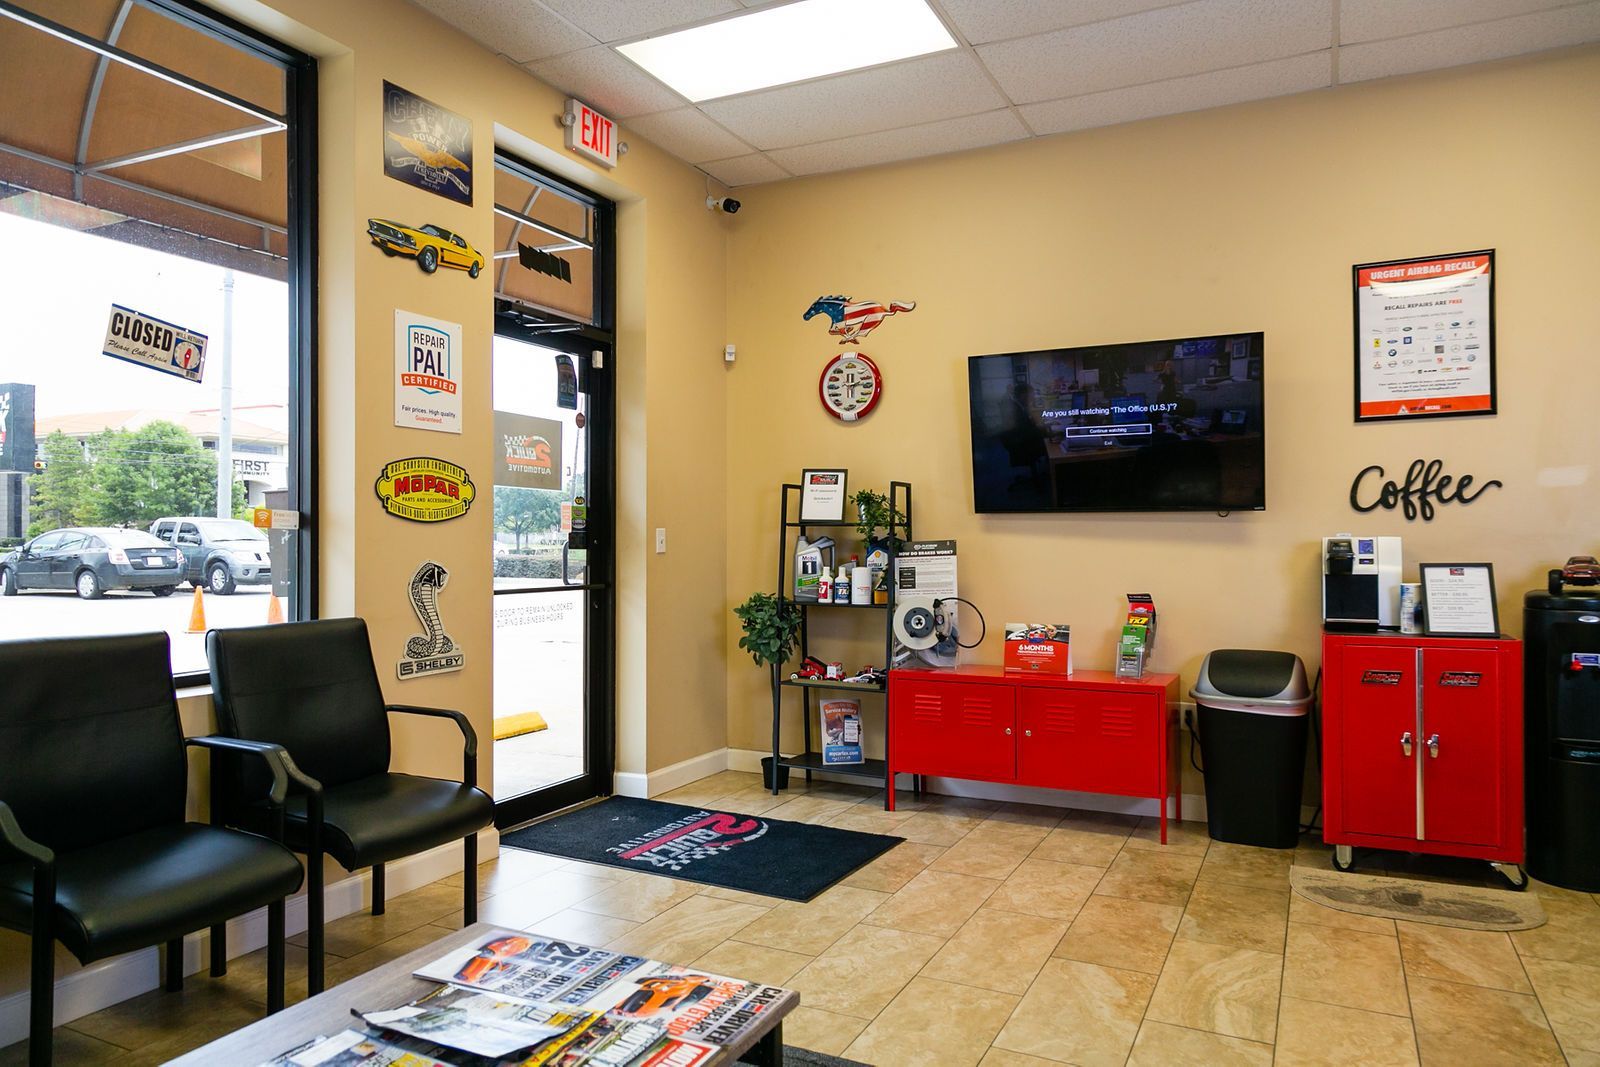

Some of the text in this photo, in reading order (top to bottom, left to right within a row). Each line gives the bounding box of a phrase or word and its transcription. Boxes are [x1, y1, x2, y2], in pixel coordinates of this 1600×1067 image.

[581, 106, 613, 158] EXIT
[1370, 260, 1477, 280] URGENT AIRBAG RECALL
[1384, 303, 1406, 311] RECALL
[111, 312, 173, 352] CLOSED
[413, 331, 446, 349] REPAIR
[108, 339, 168, 364] Please Call Again
[413, 346, 445, 377] PAL
[403, 375, 455, 392] CERTIFIED
[401, 404, 412, 412] Fair
[428, 408, 440, 417] High
[1042, 410, 1054, 418] Are
[1054, 410, 1067, 418] you
[1080, 407, 1110, 416] watching
[1127, 405, 1149, 413] Office
[232, 459, 270, 472] FIRST
[1350, 459, 1503, 521] Coffee
[806, 561, 813, 574] 1
[1018, 643, 1054, 652] 6 MONTHS
[416, 656, 460, 671] SHELBY
[605, 810, 711, 855] AUTOMOTIVE
[631, 828, 722, 866] QUICK
[542, 941, 591, 967] 25
[577, 951, 610, 967] CAR
[611, 955, 640, 974] CAR
[701, 987, 783, 1043] CAR DRIVER
